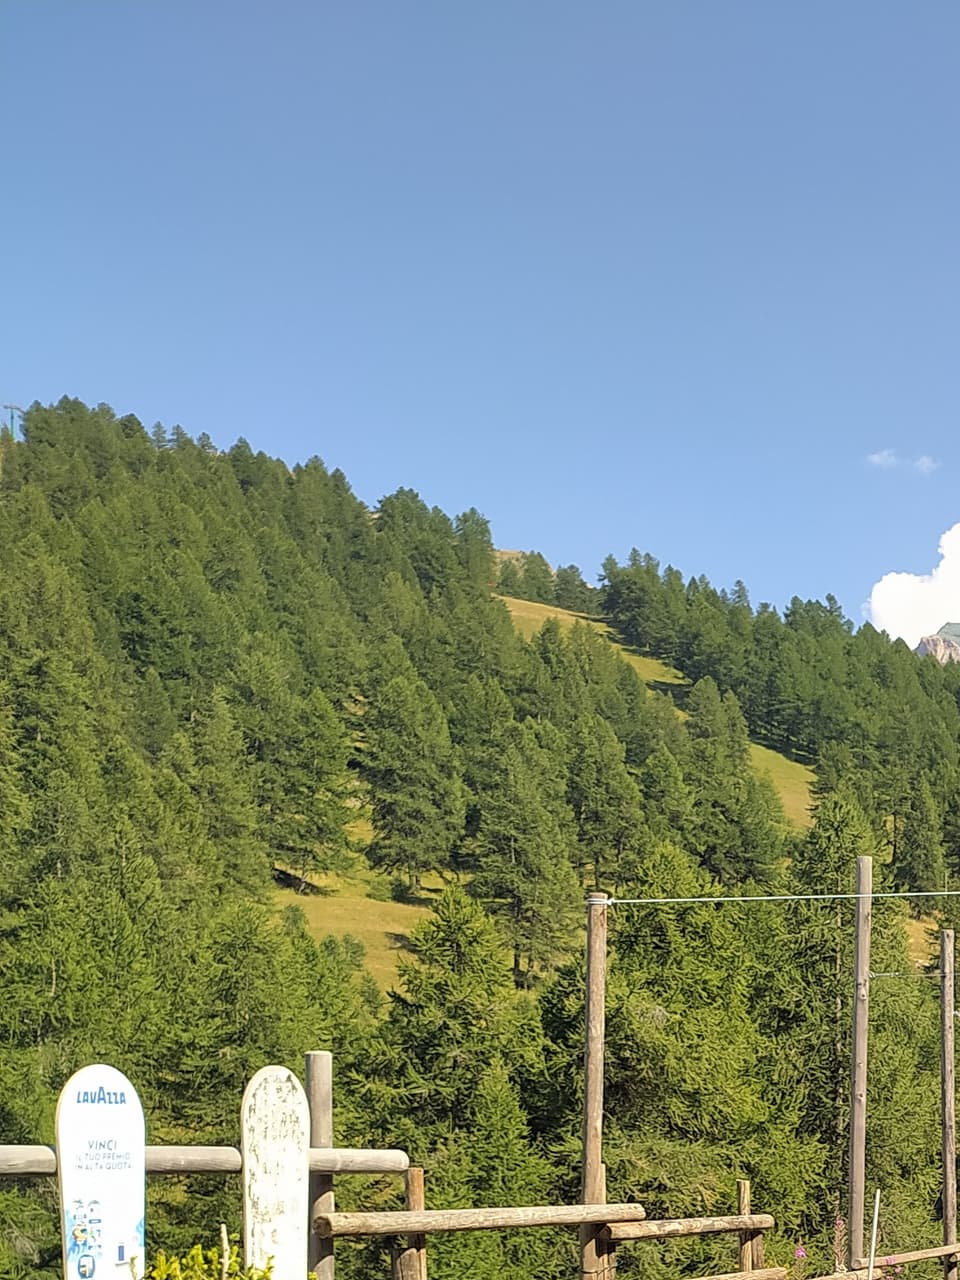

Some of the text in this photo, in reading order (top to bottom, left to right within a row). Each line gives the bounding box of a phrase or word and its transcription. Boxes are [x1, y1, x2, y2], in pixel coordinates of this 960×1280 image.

[76, 1086, 127, 1104] LAVAZZA
[88, 1139, 117, 1151] VINCI
[85, 1152, 101, 1161] TUO
[102, 1152, 131, 1161] PREMIO
[105, 1161, 132, 1170] QUOTA
